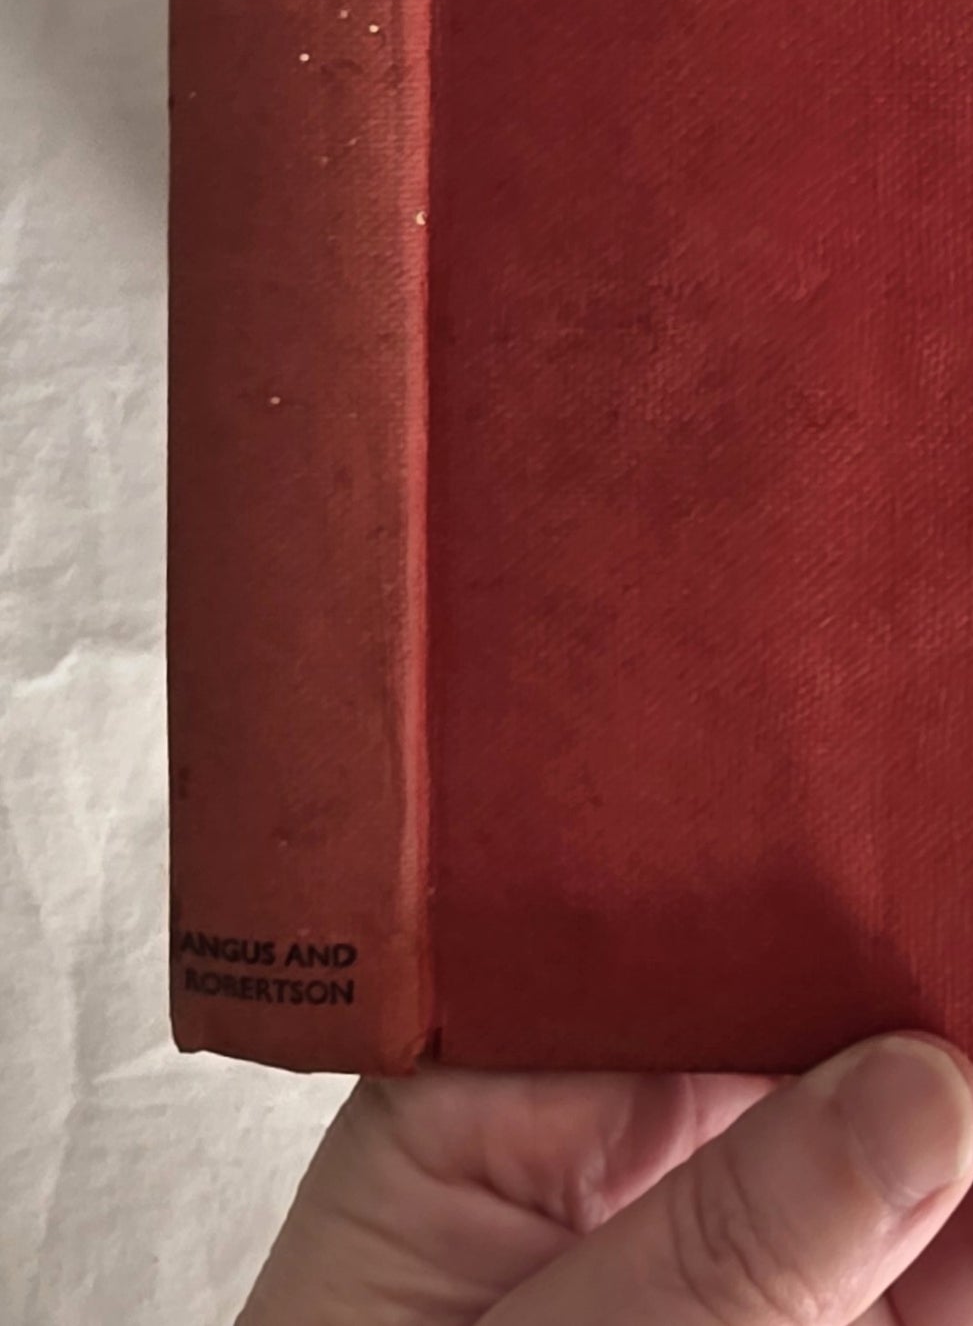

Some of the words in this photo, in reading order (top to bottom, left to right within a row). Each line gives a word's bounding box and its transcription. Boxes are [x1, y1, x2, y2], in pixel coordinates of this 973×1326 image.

[180, 931, 276, 966] ANGUS
[284, 943, 358, 969] AND
[184, 968, 355, 1005] ROBERTSON
